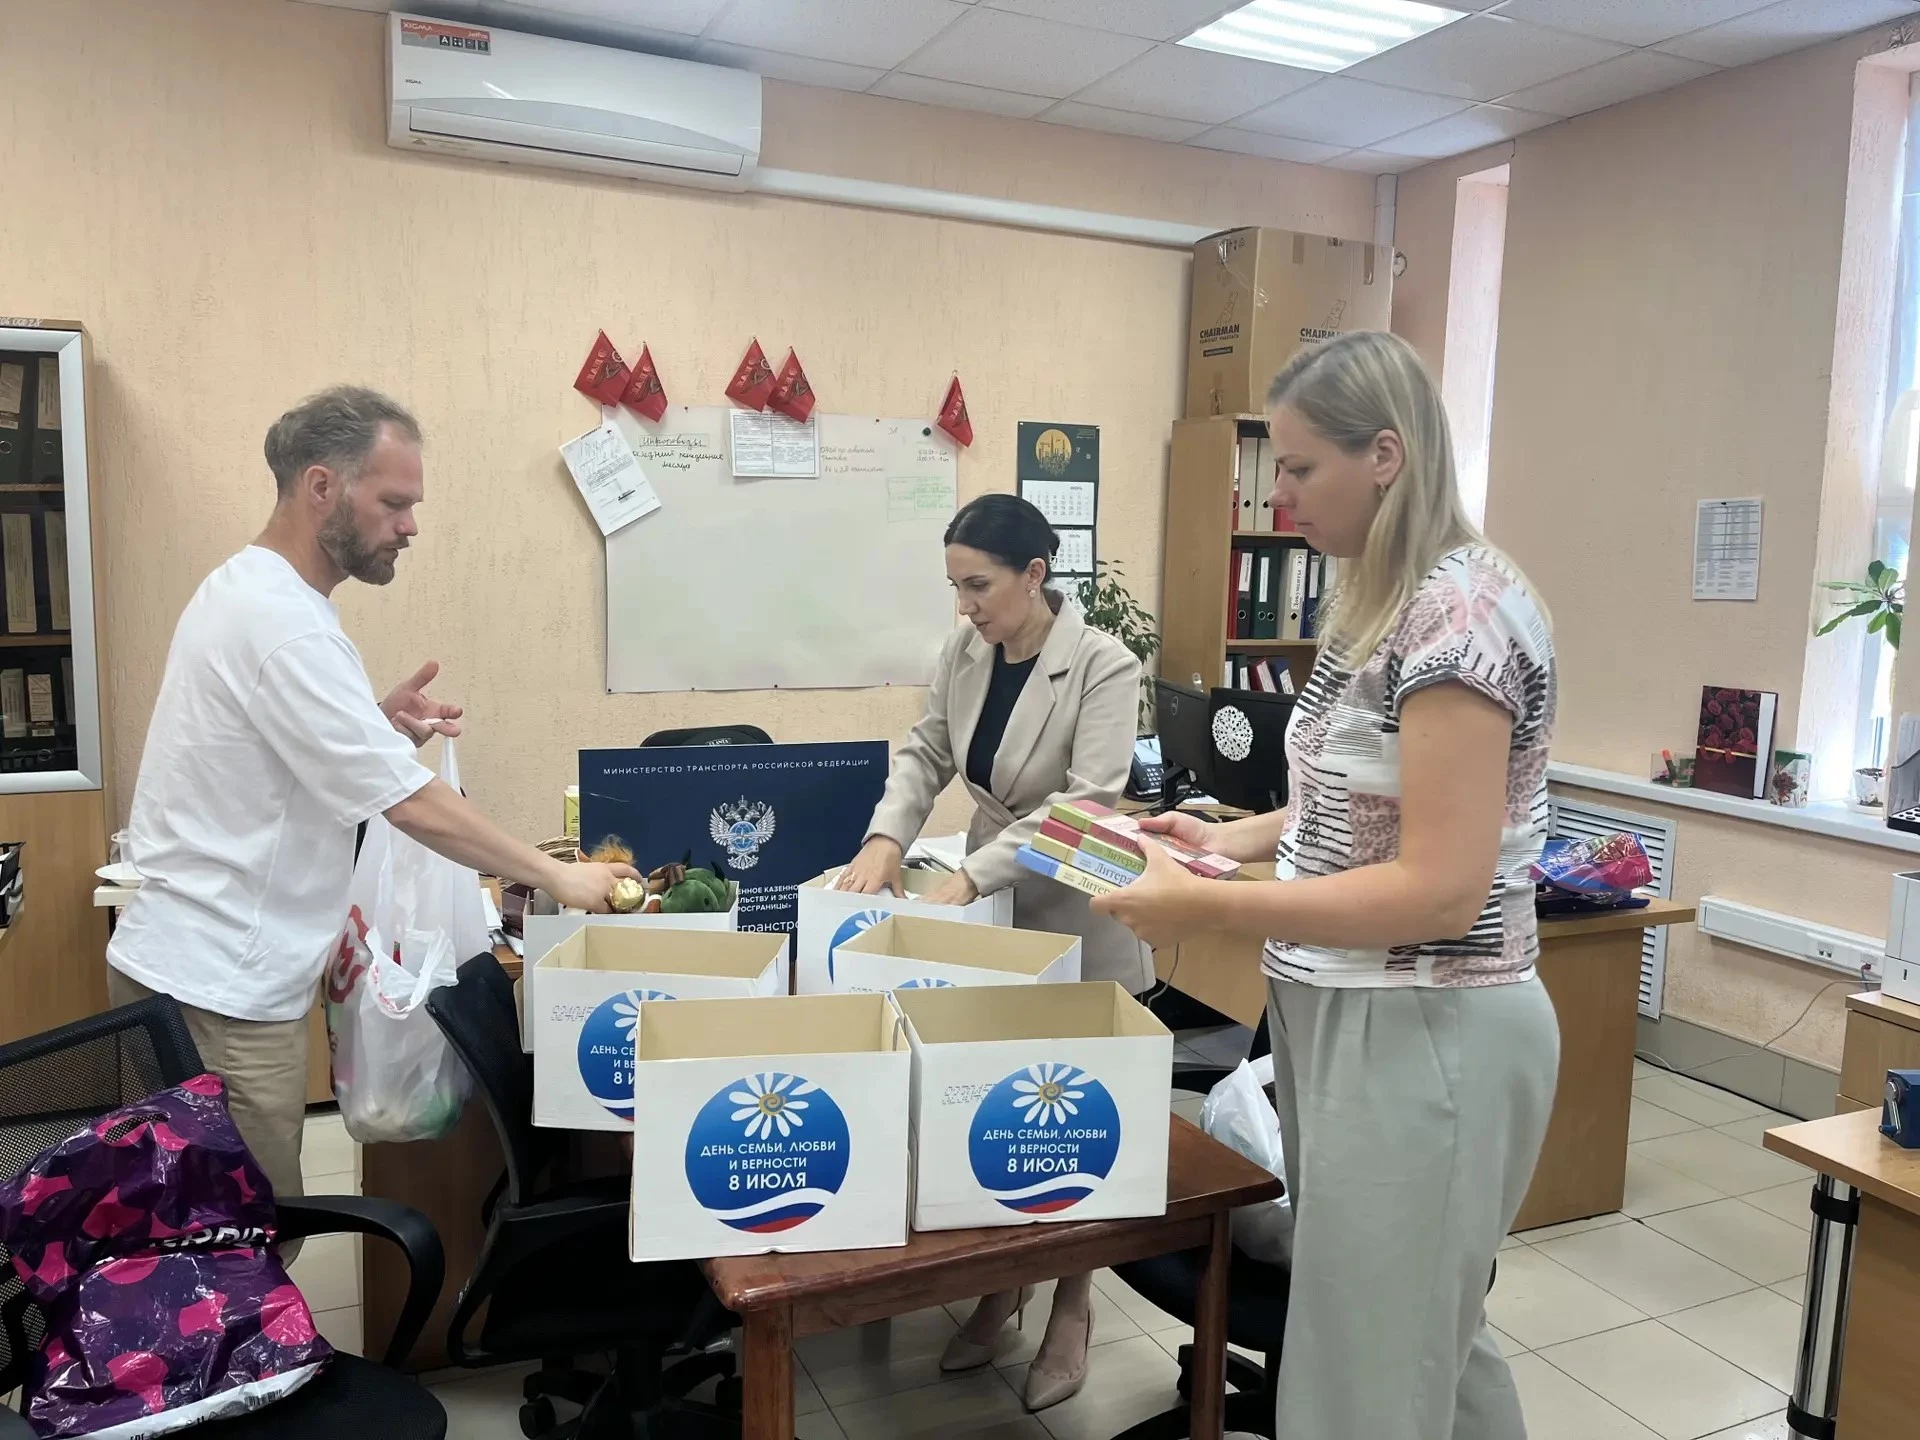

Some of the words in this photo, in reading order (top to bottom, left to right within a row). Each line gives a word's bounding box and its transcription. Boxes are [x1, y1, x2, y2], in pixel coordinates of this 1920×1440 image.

[403, 22, 433, 32] XIGMA
[1200, 323, 1240, 339] CHAIRMAN
[1300, 327, 1344, 340] CHAIRM
[603, 765, 683, 775] МИНИСТЕРСТВО
[687, 762, 749, 772] ТРАНСПОРТА
[751, 758, 814, 770] РОССИЙСКОЙ
[817, 758, 870, 768] ФЕДЕРАЦИИ
[1094, 863, 1133, 885] Литера
[738, 886, 763, 895] ЕННОЕ
[764, 884, 798, 893] КАЗЕННО
[737, 895, 769, 904] ЕЛЬСТВУ
[777, 893, 798, 901] ЭКСП
[590, 1045, 618, 1055] ДЕНЬ
[613, 1059, 621, 1068] И
[613, 1071, 623, 1085] 8
[982, 1129, 1014, 1141] ДЕНЬ
[1017, 1128, 1061, 1140] СЕМЬИ,
[1064, 1128, 1107, 1139] ЛЮБВИ
[700, 1145, 735, 1157] ДЕНЬ
[737, 1142, 787, 1155] СЕМЬИ,
[789, 1140, 837, 1152] ЛЮБВИ
[1008, 1144, 1017, 1154] И
[1020, 1143, 1080, 1154] ВЕРНОСТИ
[729, 1160, 738, 1170] И
[741, 1157, 807, 1170] ВЕРНОСТИ
[1007, 1158, 1017, 1173] 8
[1023, 1157, 1079, 1173] ИЮЛЯ
[728, 1174, 740, 1190] 8
[746, 1171, 807, 1190] ИЮЛЯ
